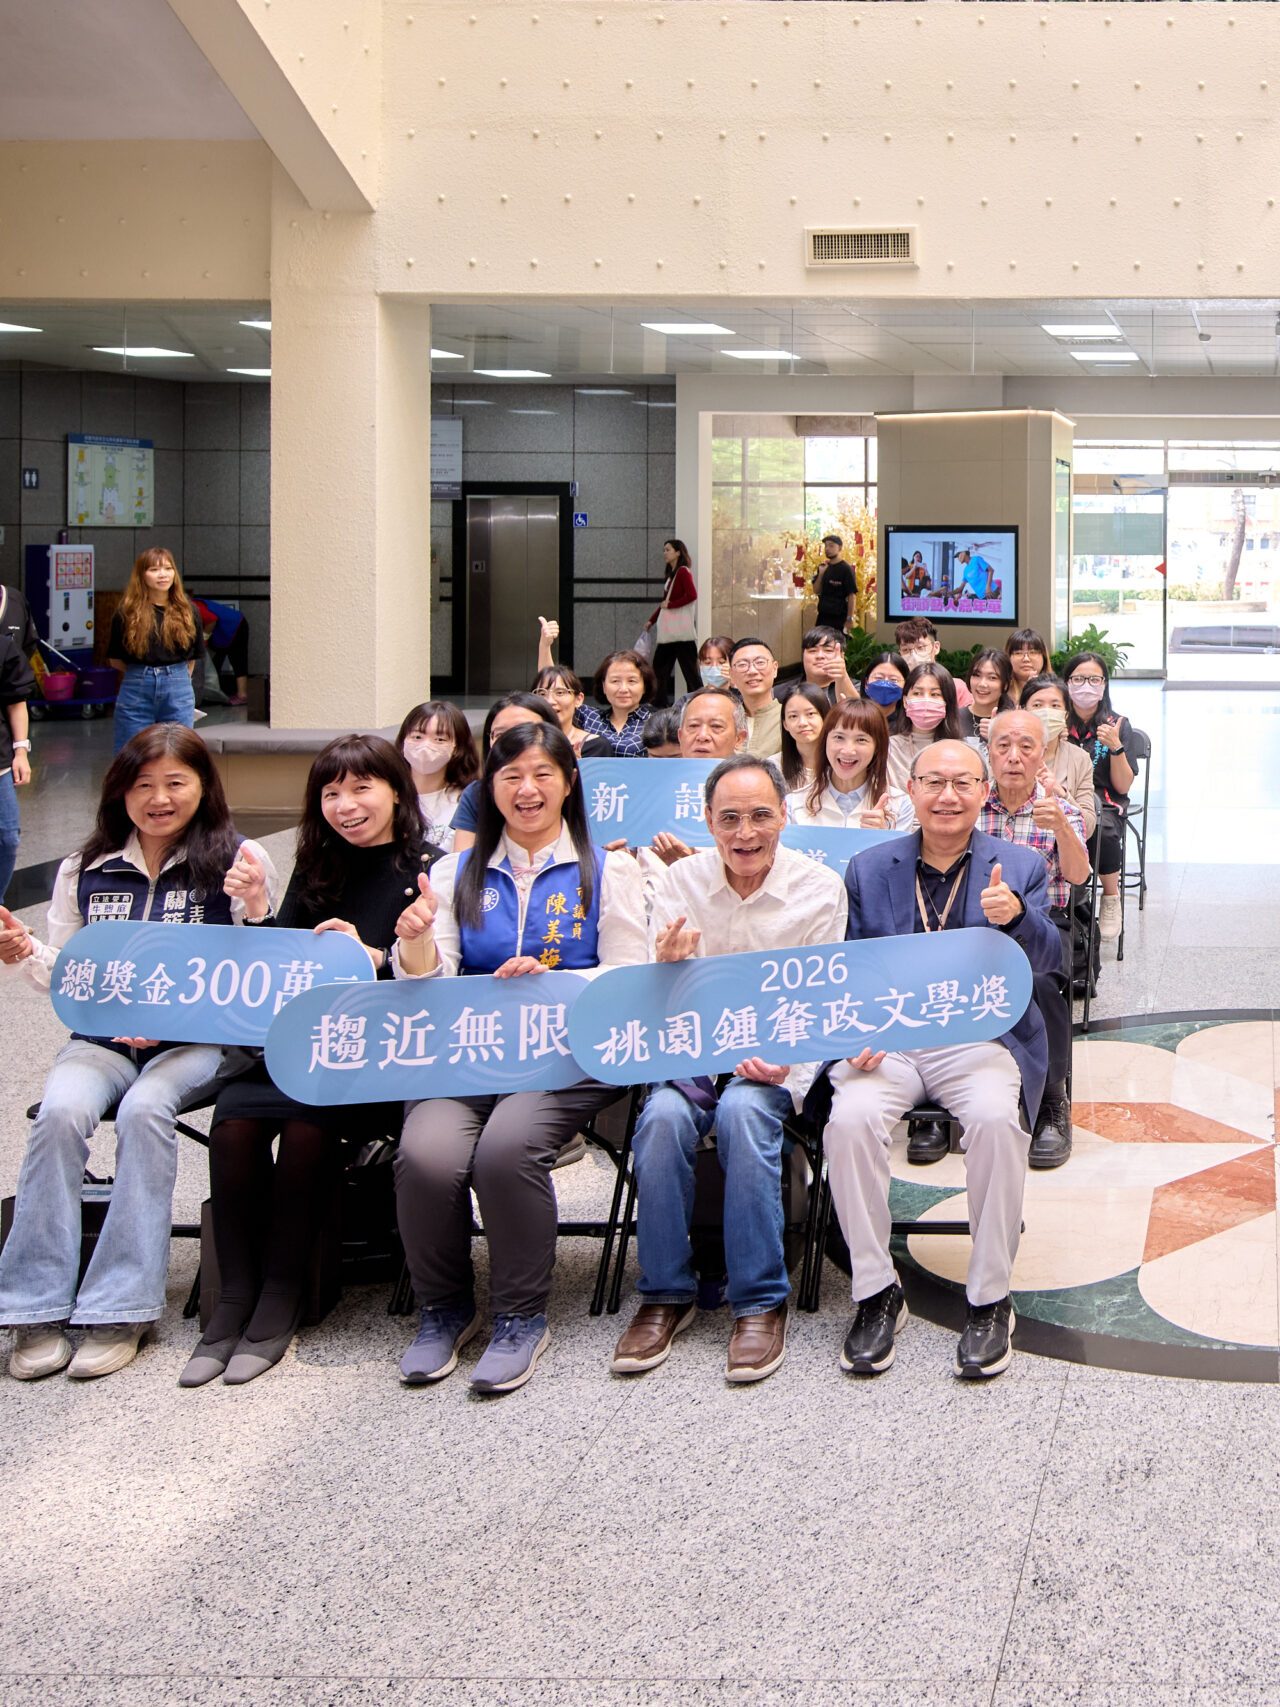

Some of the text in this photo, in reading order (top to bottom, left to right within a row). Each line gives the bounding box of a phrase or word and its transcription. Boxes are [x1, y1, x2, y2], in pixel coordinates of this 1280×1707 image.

[539, 891, 569, 969] 陳美梅
[760, 952, 849, 992] 2026
[308, 1003, 571, 1073] 趨近無限
[593, 974, 1012, 1067] 桃園鍾肇政文學獎
